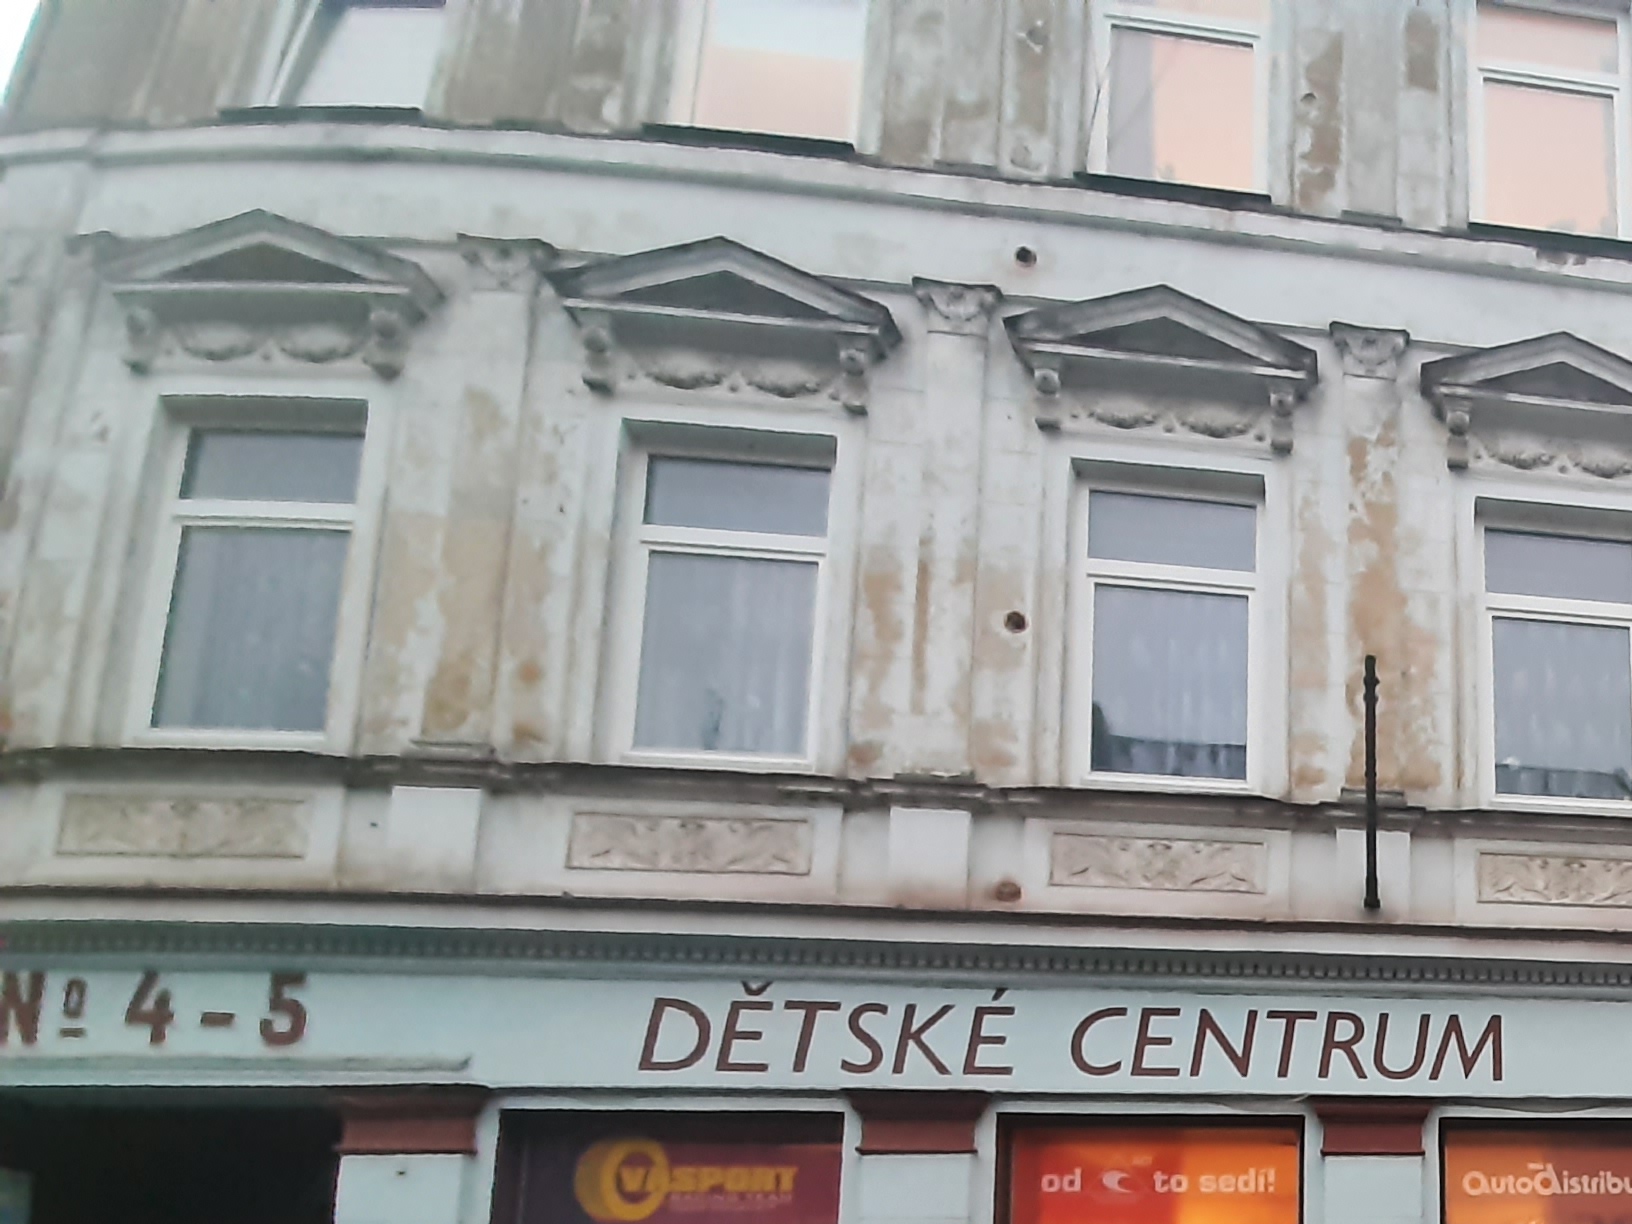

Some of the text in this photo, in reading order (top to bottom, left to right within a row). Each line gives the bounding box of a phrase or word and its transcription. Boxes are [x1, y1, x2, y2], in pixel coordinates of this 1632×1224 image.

[637, 980, 1016, 1076] DĚTSKÉ
[1070, 1004, 1505, 1083] CENTRUM
[1041, 1167, 1276, 1193] od to sedí!
